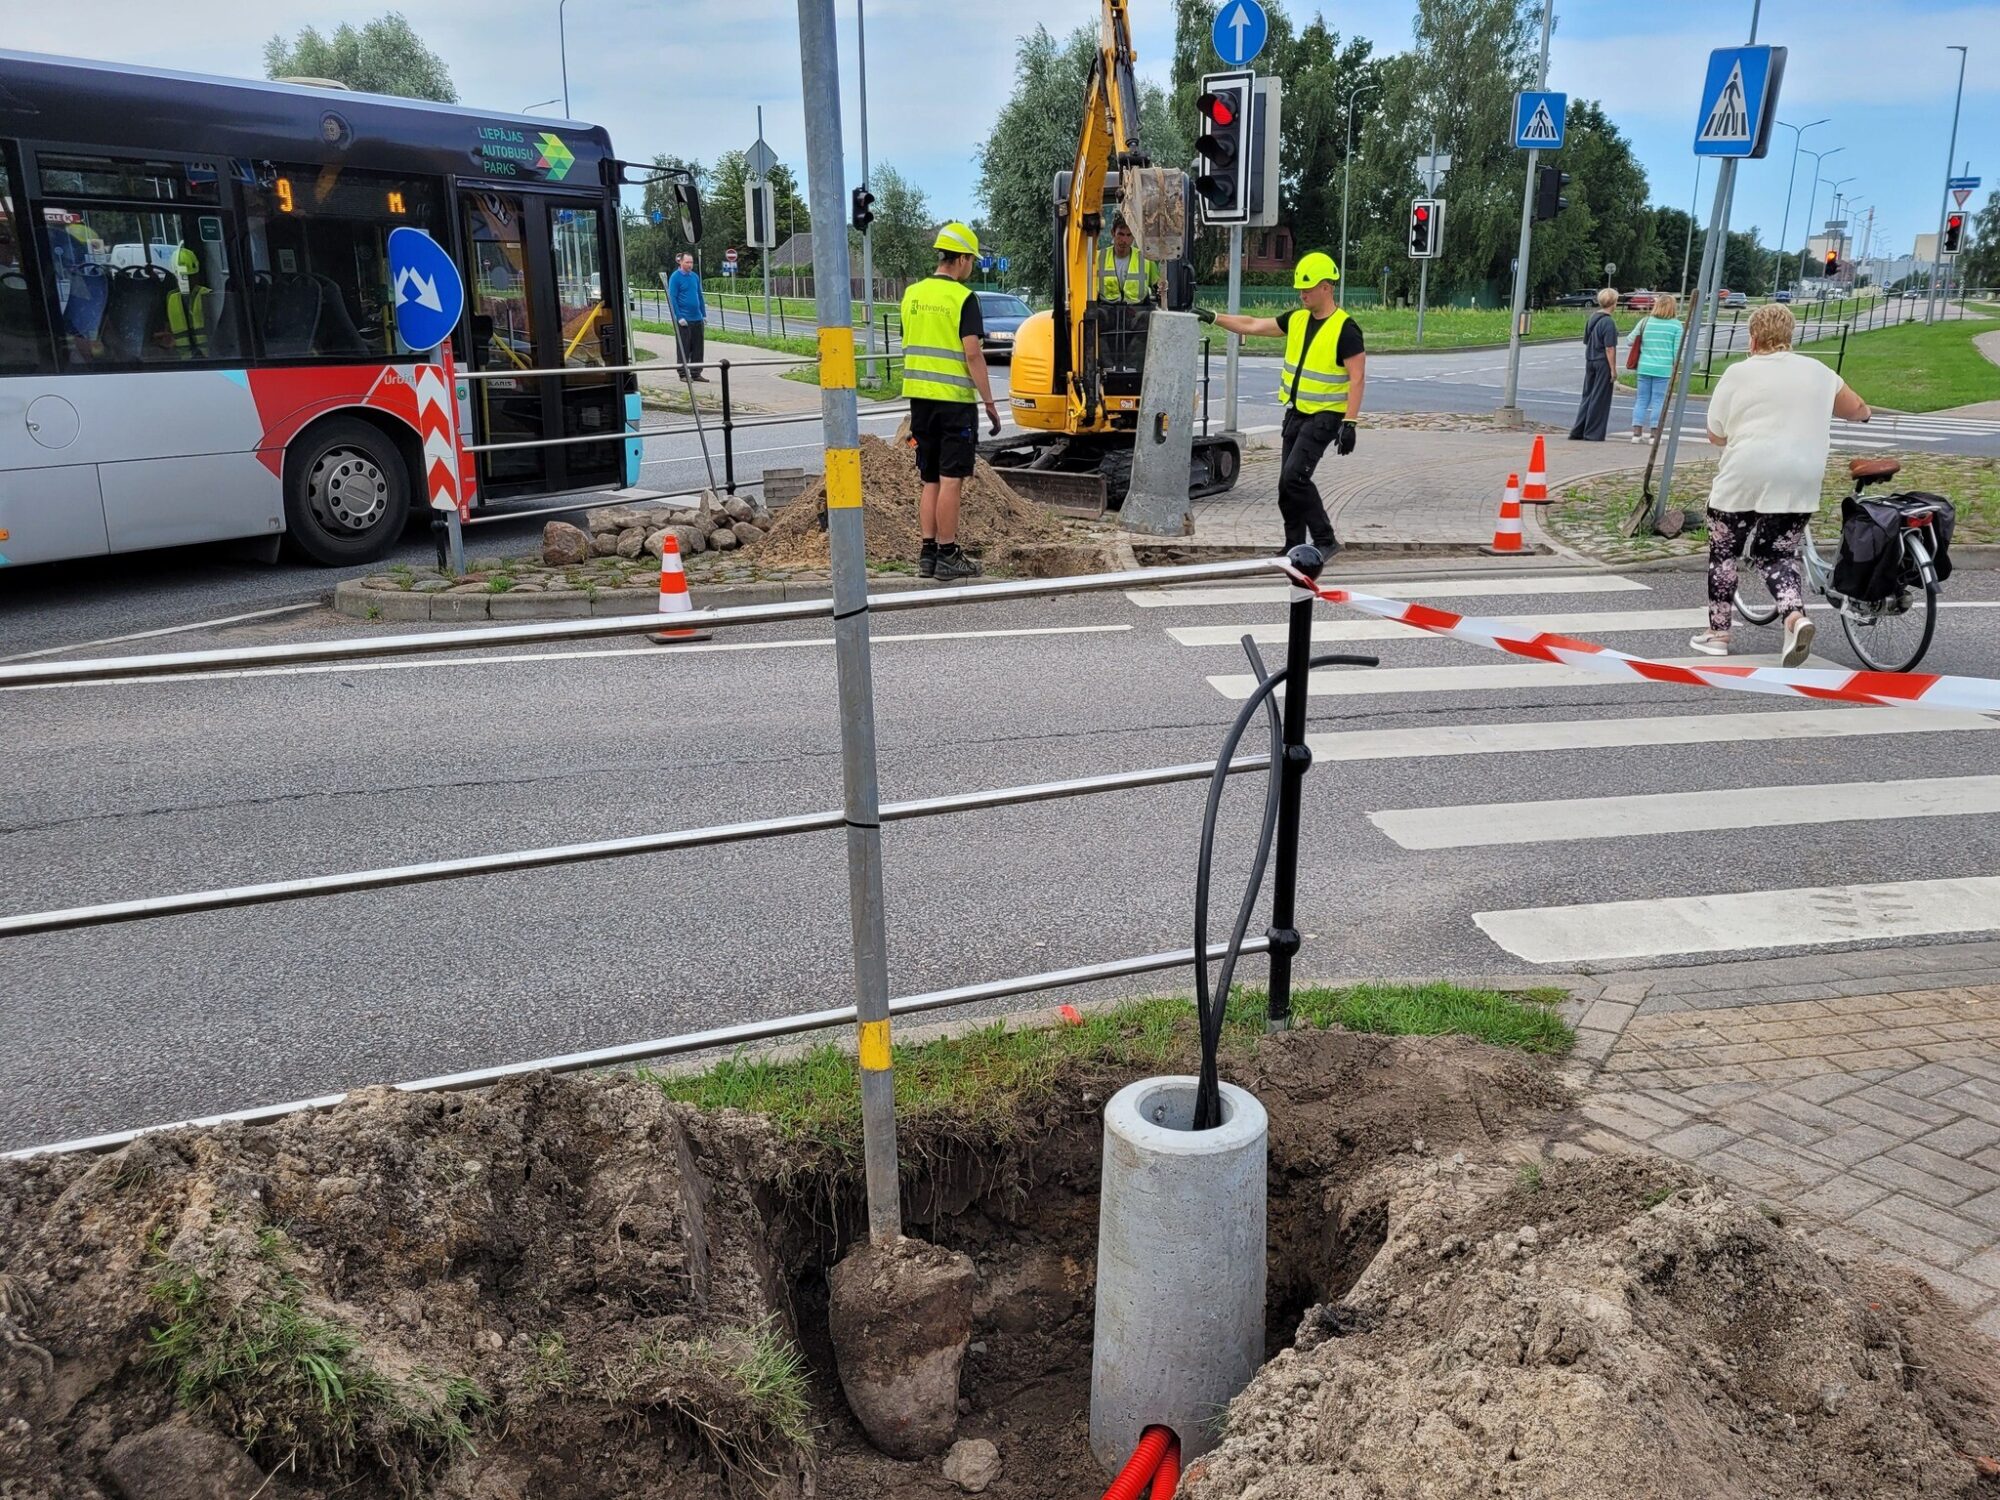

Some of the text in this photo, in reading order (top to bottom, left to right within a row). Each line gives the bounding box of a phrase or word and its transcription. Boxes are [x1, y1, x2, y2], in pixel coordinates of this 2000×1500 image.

[477, 126, 524, 143] LIEPĀJAS
[481, 143, 534, 160] AUTOBUSU
[484, 161, 516, 176] PARKS
[277, 178, 293, 212] 9
[384, 373, 415, 385] Urbin
